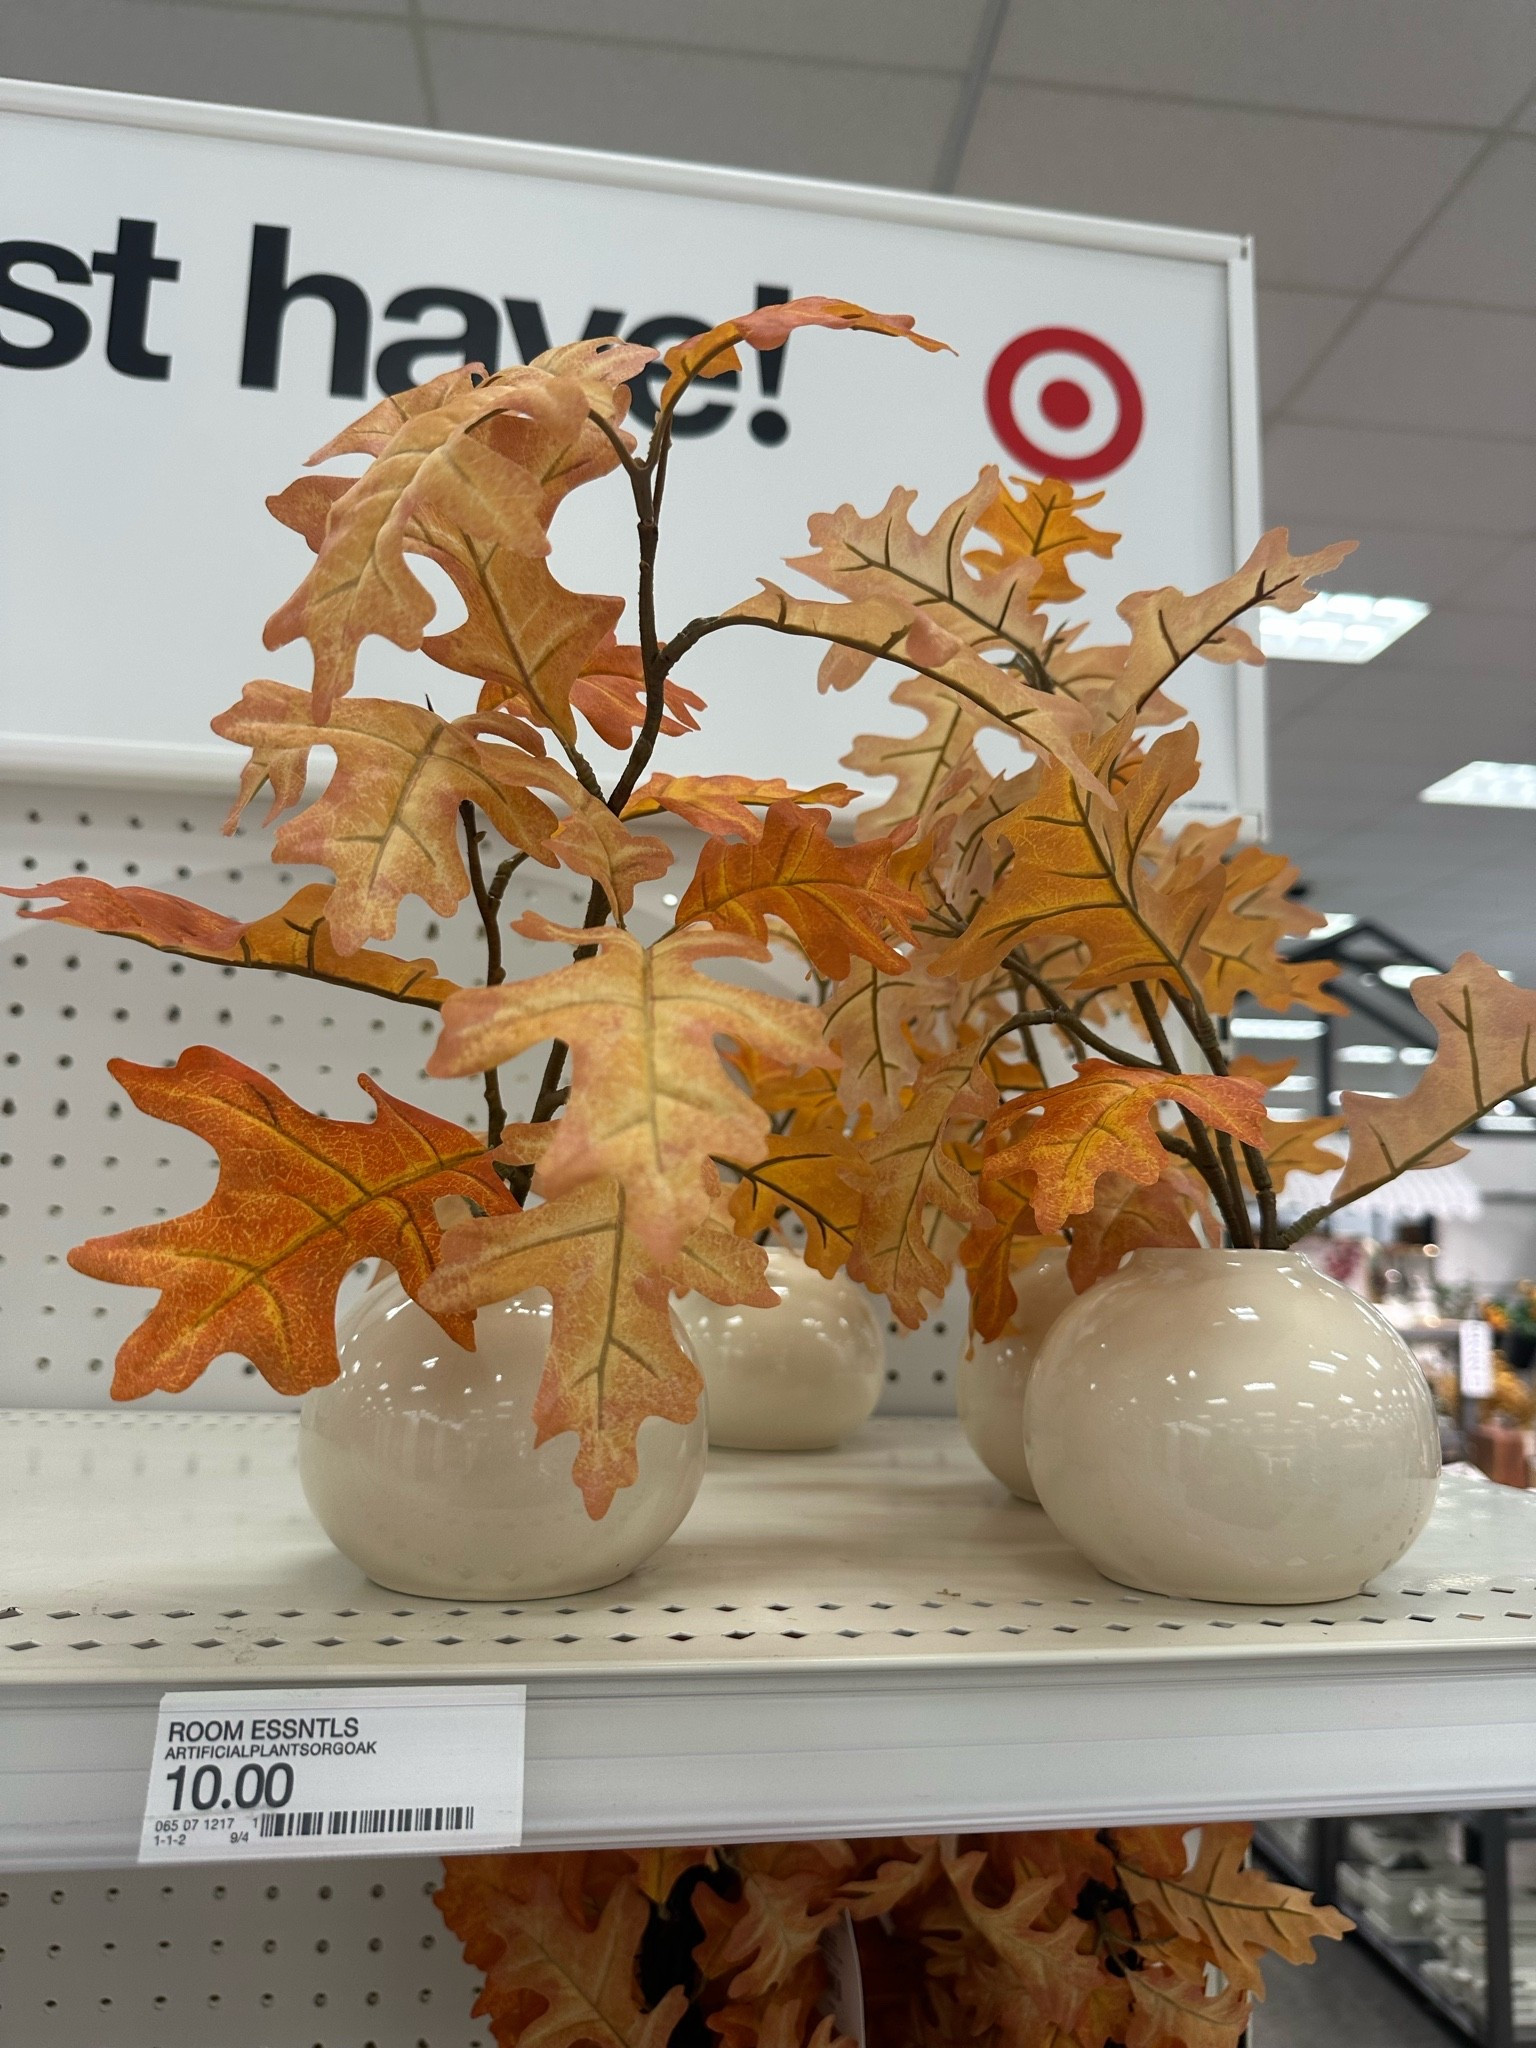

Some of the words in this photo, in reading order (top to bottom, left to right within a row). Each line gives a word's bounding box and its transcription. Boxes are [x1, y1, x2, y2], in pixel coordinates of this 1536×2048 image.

[0, 217, 181, 382] st
[168, 1720, 244, 1742] ROOM
[251, 1717, 360, 1741] ESSNTLS
[165, 1741, 377, 1760] ARTIFICIALPLANTSORGOAK
[166, 1762, 295, 1811] 10.00
[155, 1820, 179, 1833] 065
[183, 1819, 200, 1831] 07
[204, 1818, 235, 1831] 1217
[154, 1834, 187, 1846] 1-1-2
[230, 1831, 249, 1844] 9/4
